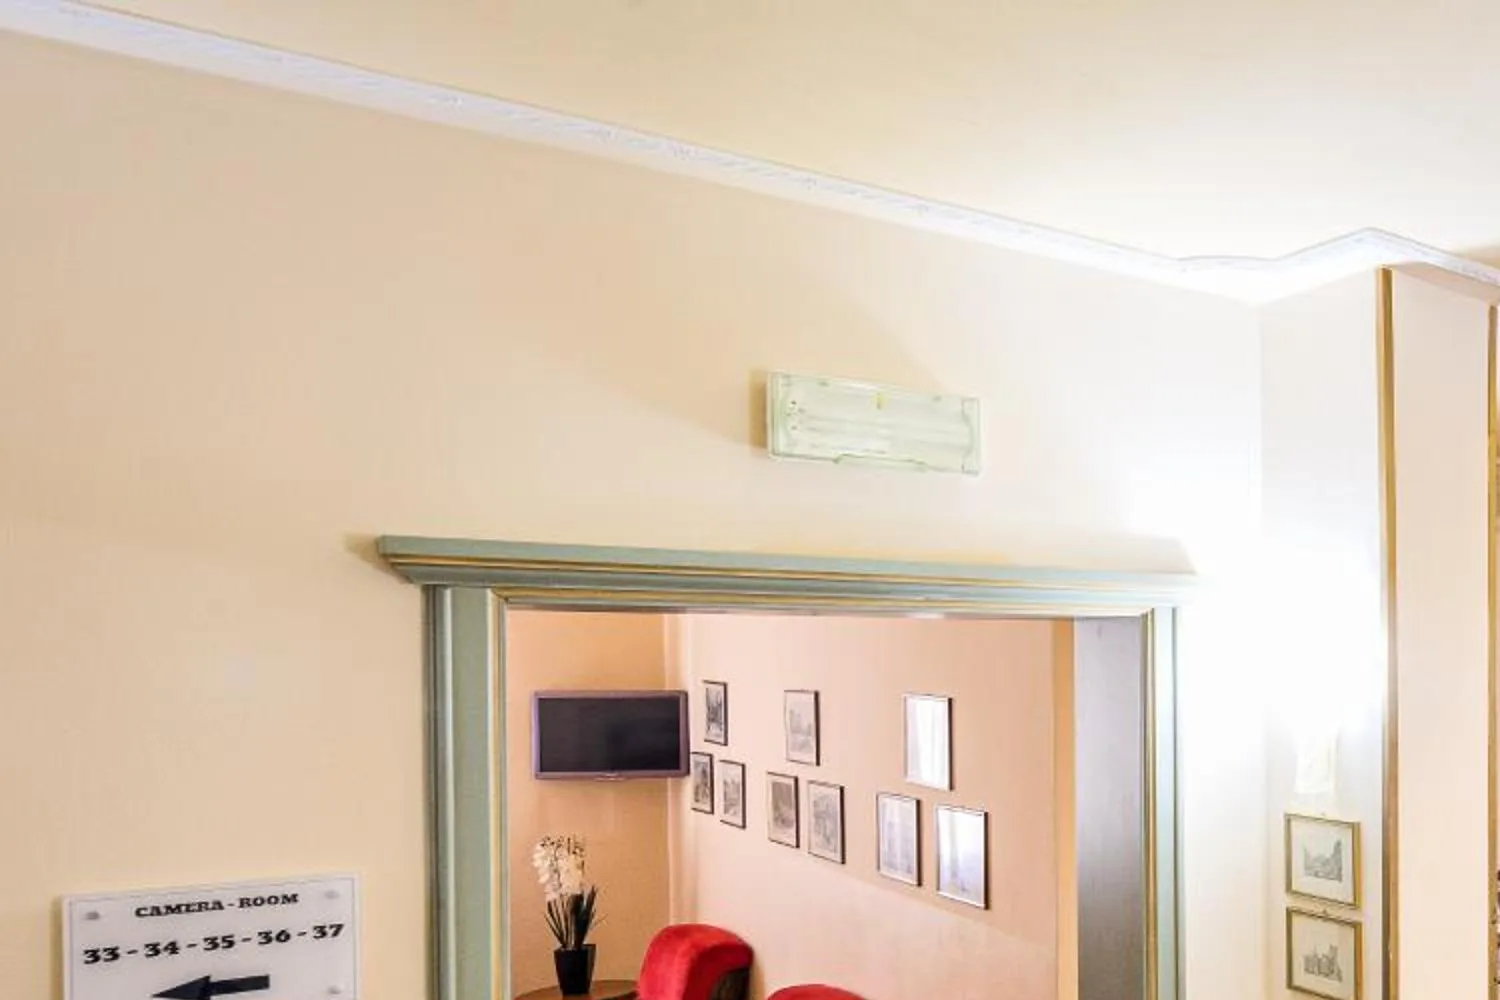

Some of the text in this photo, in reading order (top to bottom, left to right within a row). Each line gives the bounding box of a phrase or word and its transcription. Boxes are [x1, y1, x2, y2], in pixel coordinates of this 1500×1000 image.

[135, 900, 225, 918] CAMERA
[238, 894, 298, 908] ROOM
[83, 946, 121, 965] 33
[144, 940, 180, 958] 34
[203, 934, 236, 951] 35
[258, 929, 291, 945] 36
[313, 924, 344, 939] 37
